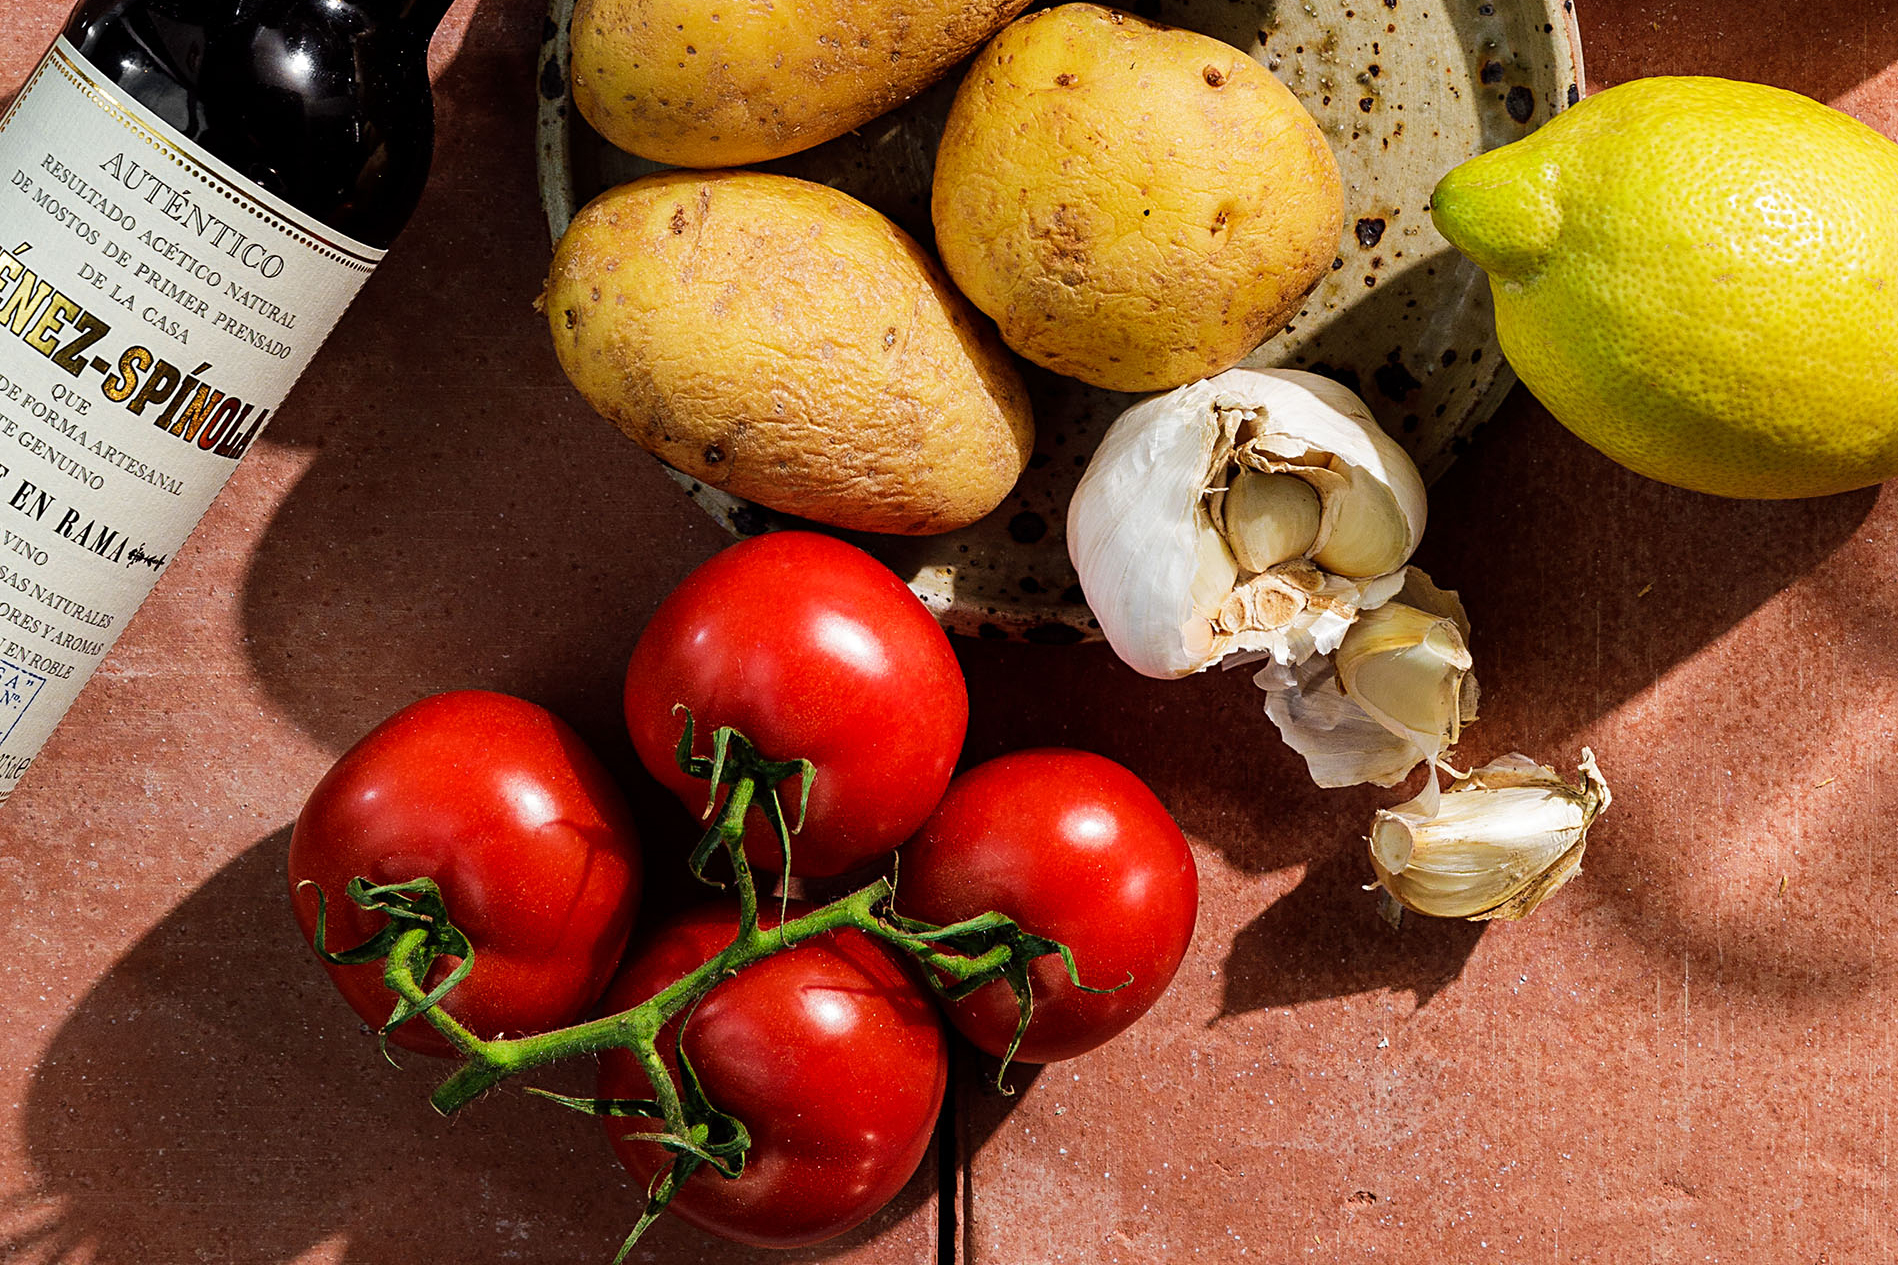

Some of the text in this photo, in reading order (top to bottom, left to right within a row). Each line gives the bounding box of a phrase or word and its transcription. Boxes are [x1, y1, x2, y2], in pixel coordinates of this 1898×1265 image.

[40, 153, 298, 329] RESULTADO ACÉTICO NATURAL
[99, 152, 284, 278] AUTÉNTICO
[11, 169, 292, 360] DE MOSTOS DE PRIMER PRENSADO
[77, 262, 190, 344] DE LA CASA
[0, 241, 270, 459] ÉNEZ-SPÍNOLA
[51, 383, 92, 416] QUE
[18, 431, 105, 490] GENUINO
[20, 393, 88, 446] FORMA
[88, 440, 184, 496] ARTESANAL
[3, 530, 49, 566] VINO
[8, 479, 129, 563] EN RAMA
[29, 584, 114, 629] NATURALES
[41, 624, 55, 639] Y
[50, 631, 104, 656] AROMAS
[3, 641, 31, 662] EN
[28, 653, 74, 680] ROBLE
